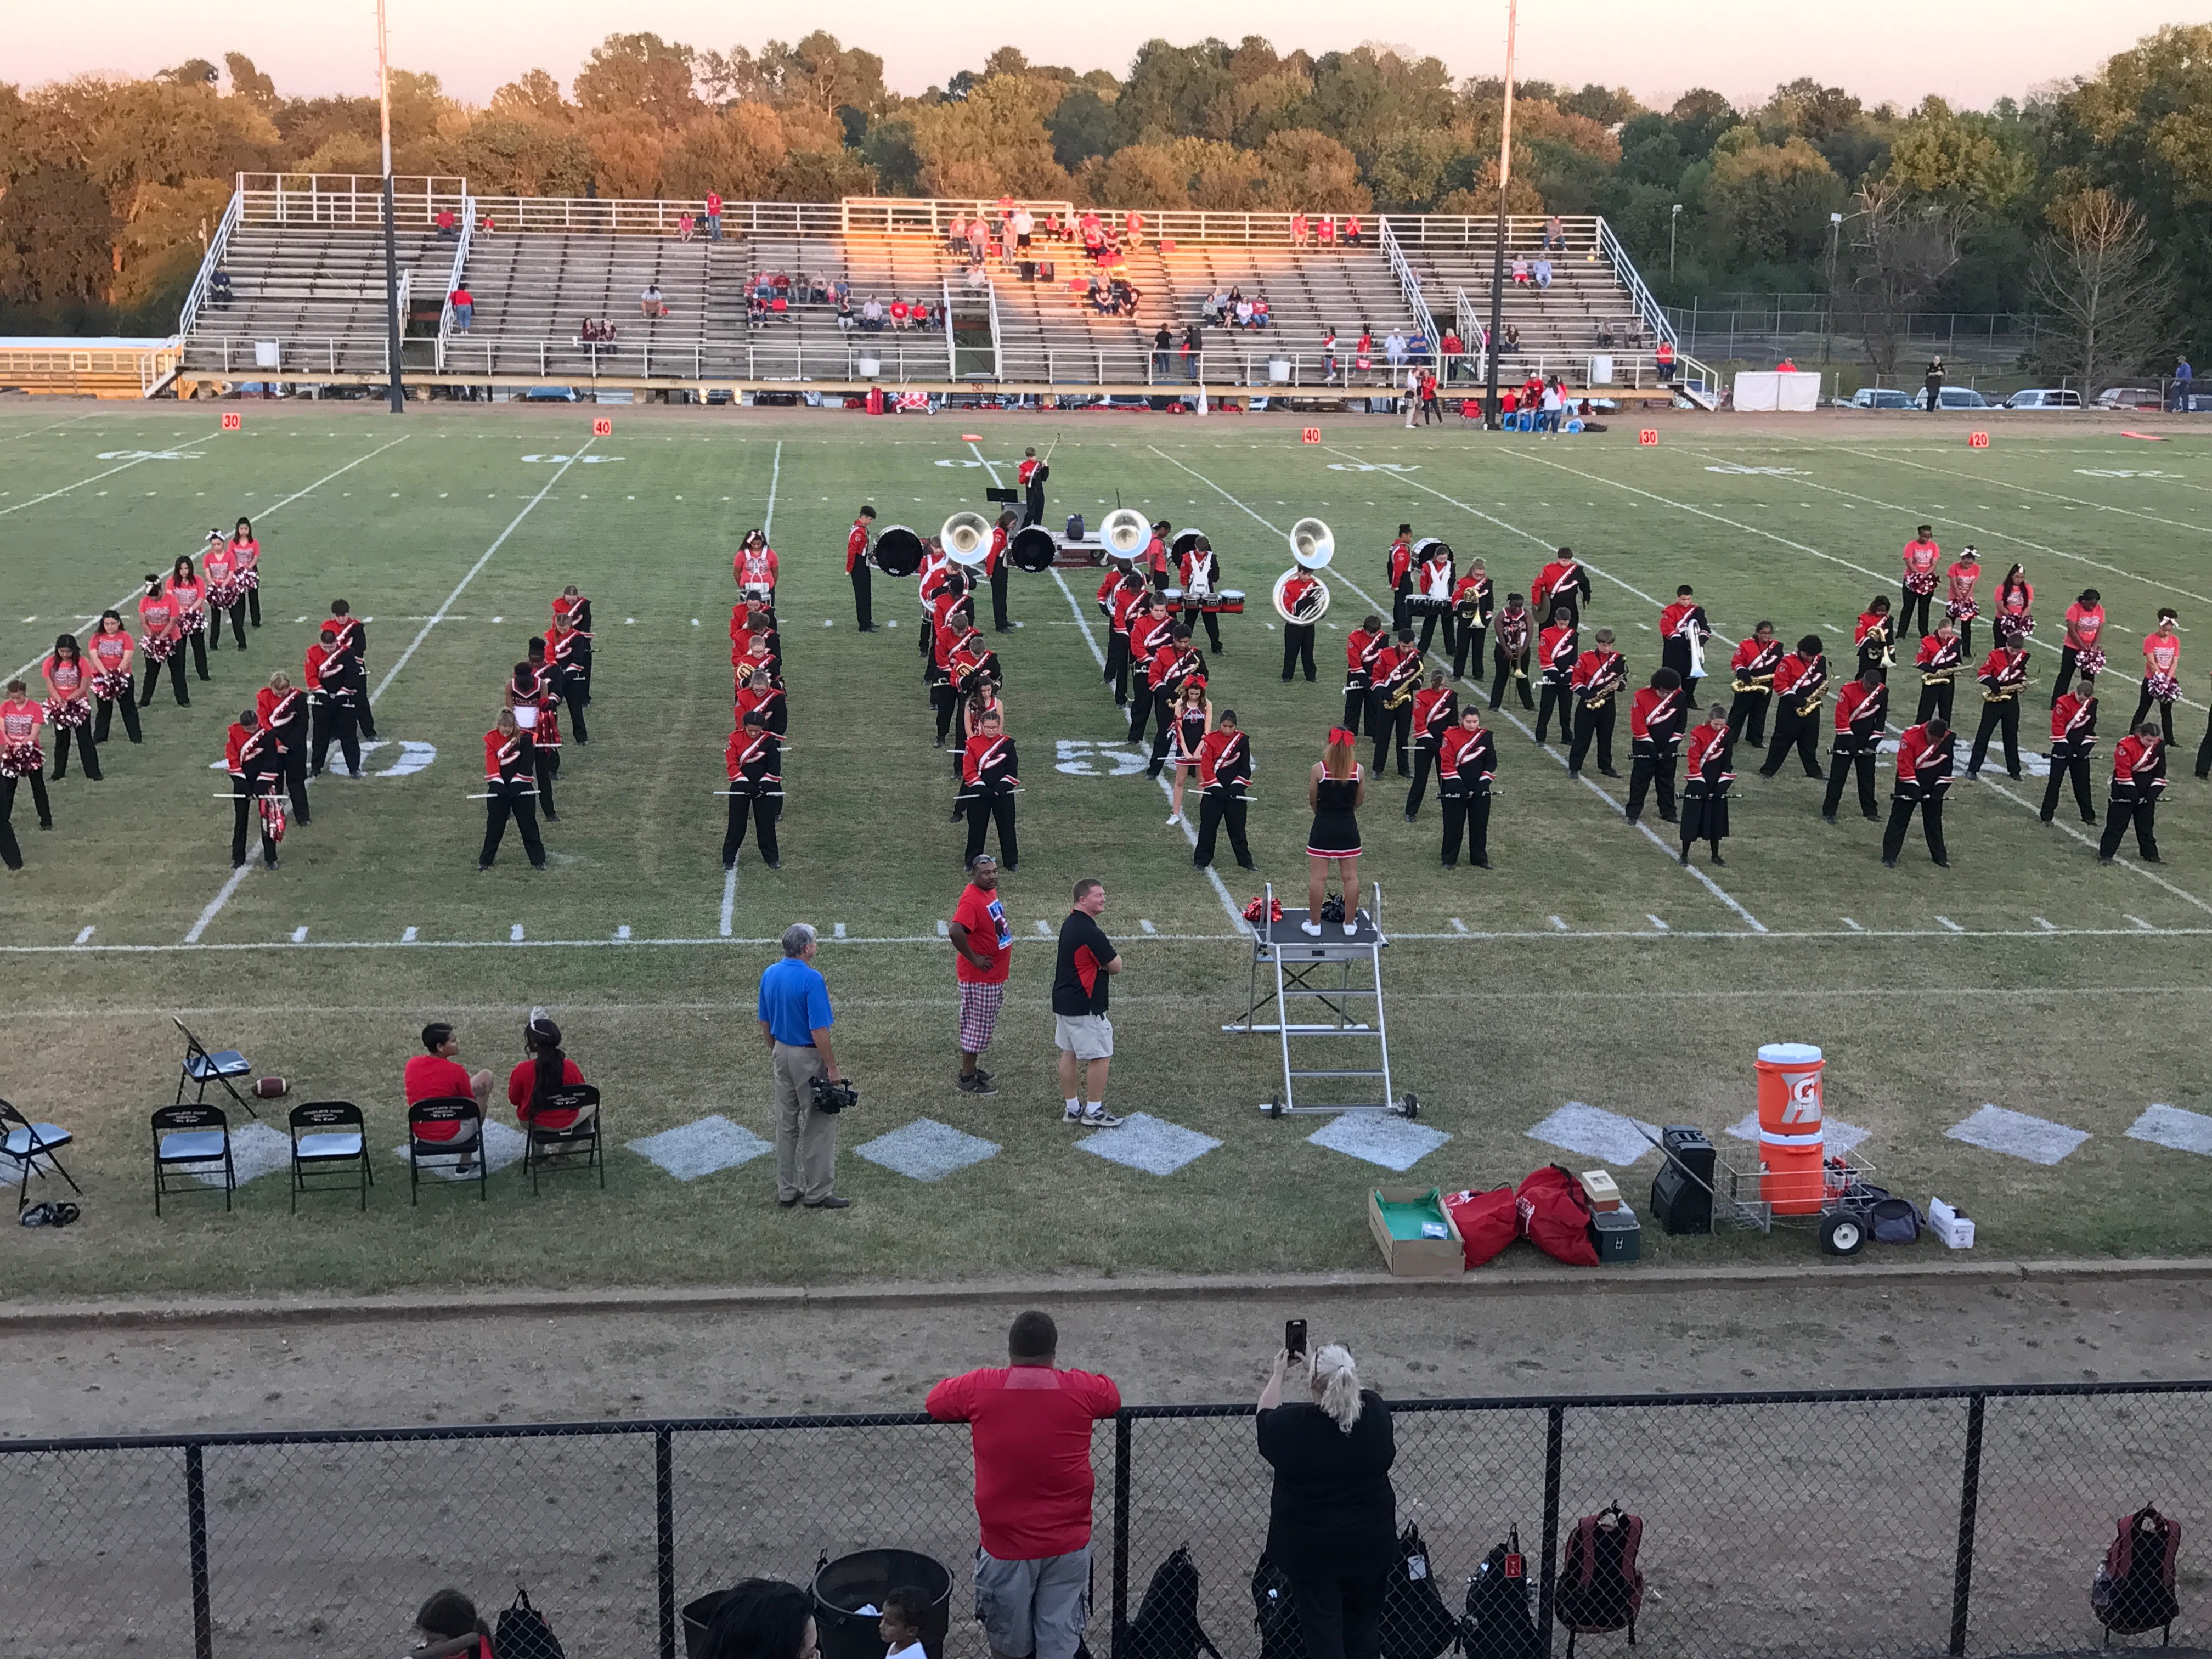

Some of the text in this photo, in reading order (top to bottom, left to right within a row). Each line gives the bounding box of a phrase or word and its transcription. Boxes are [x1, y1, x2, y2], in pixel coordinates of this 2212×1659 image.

[972, 383, 984, 391] 50
[224, 415, 238, 427] 30
[596, 422, 609, 433] 40
[1306, 429, 1318, 442] 40
[1644, 431, 1656, 443] 30
[1975, 434, 1987, 445] 20
[1794, 1077, 1815, 1103] G
